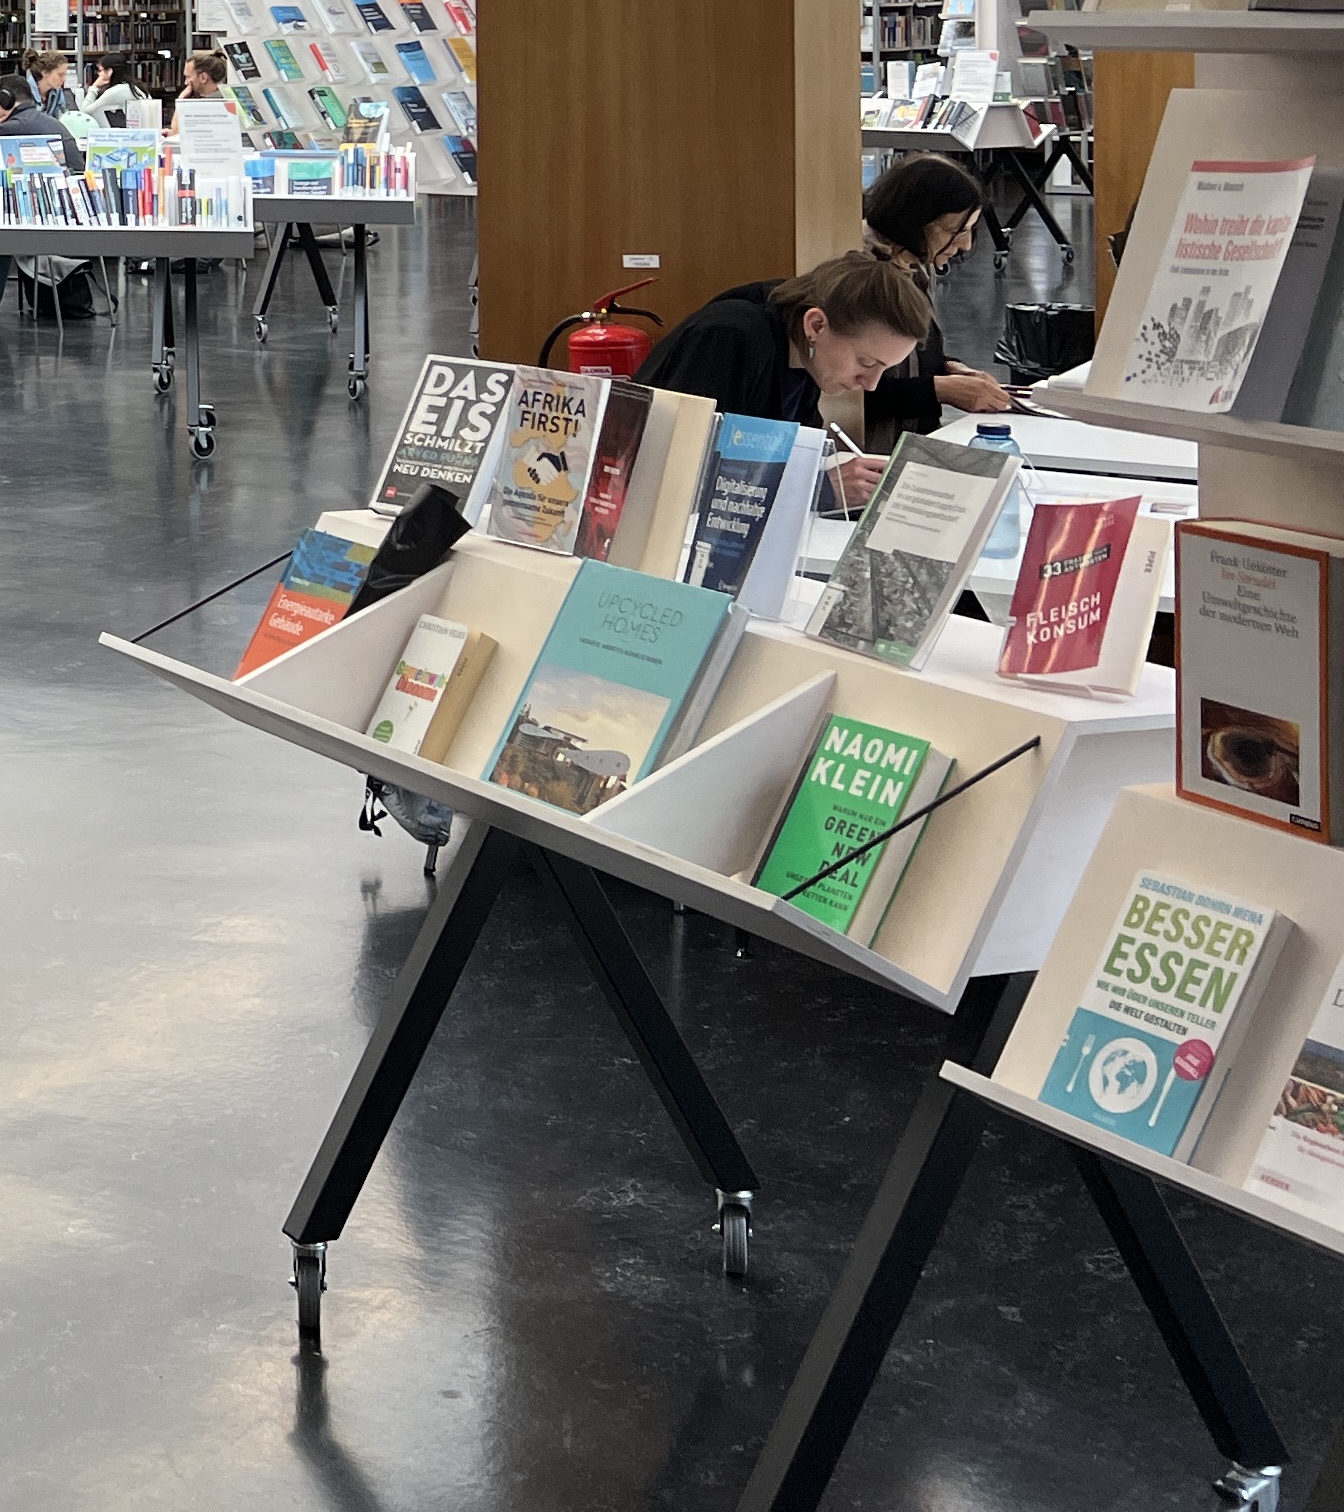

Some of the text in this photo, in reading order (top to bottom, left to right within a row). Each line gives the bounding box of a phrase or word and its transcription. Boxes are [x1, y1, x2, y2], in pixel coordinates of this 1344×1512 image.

[422, 364, 509, 404] DAS
[408, 394, 497, 442] EIS
[518, 389, 586, 418] AFRIKA
[519, 410, 579, 438] FIRST!
[403, 432, 485, 455] SCHMILZT
[393, 463, 473, 484] NEU DENKEN
[706, 512, 751, 538] Entwicklung
[1043, 561, 1062, 578] 33
[1209, 549, 1239, 568] Frank
[597, 590, 684, 628] UPCYCLED
[1201, 590, 1299, 624] Umweltgeschichte
[1237, 584, 1262, 601] Eine
[268, 612, 305, 637] Gebäude
[1026, 591, 1101, 628] FLEISCH
[1198, 604, 1300, 640] der modernen Welt
[601, 612, 662, 644] HOMES
[1026, 607, 1101, 646] KONSUM
[823, 725, 919, 776] NAOMI
[809, 756, 905, 808] KLEIN
[1139, 876, 1196, 904] SEBASTIAN
[1122, 893, 1255, 967] BESSER
[1103, 932, 1239, 1015] ESSEN
[1108, 999, 1189, 1036] DIE WELT GESTALTEN
[1186, 1011, 1217, 1031] TELLER
